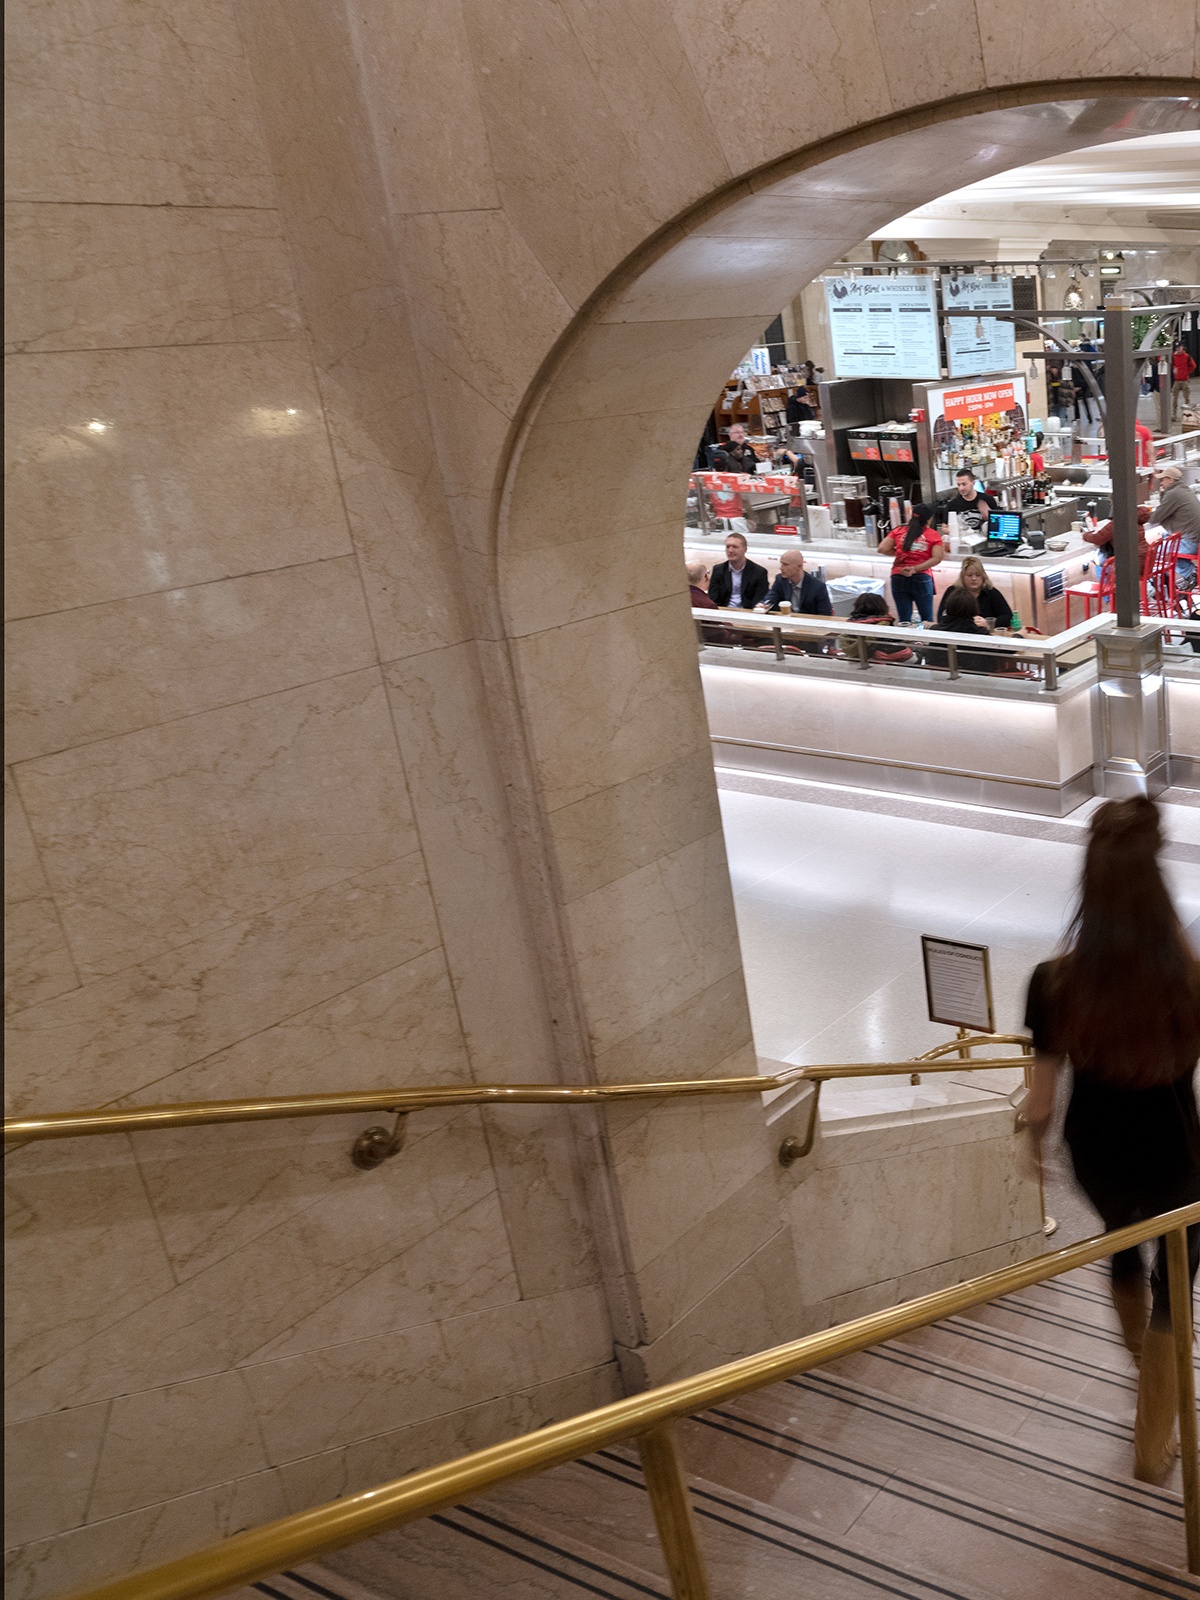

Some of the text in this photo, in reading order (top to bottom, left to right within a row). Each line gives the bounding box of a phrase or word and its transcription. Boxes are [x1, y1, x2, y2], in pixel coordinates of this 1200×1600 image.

[945, 388, 1013, 407] HAPPY HOUR NOW OPEN
